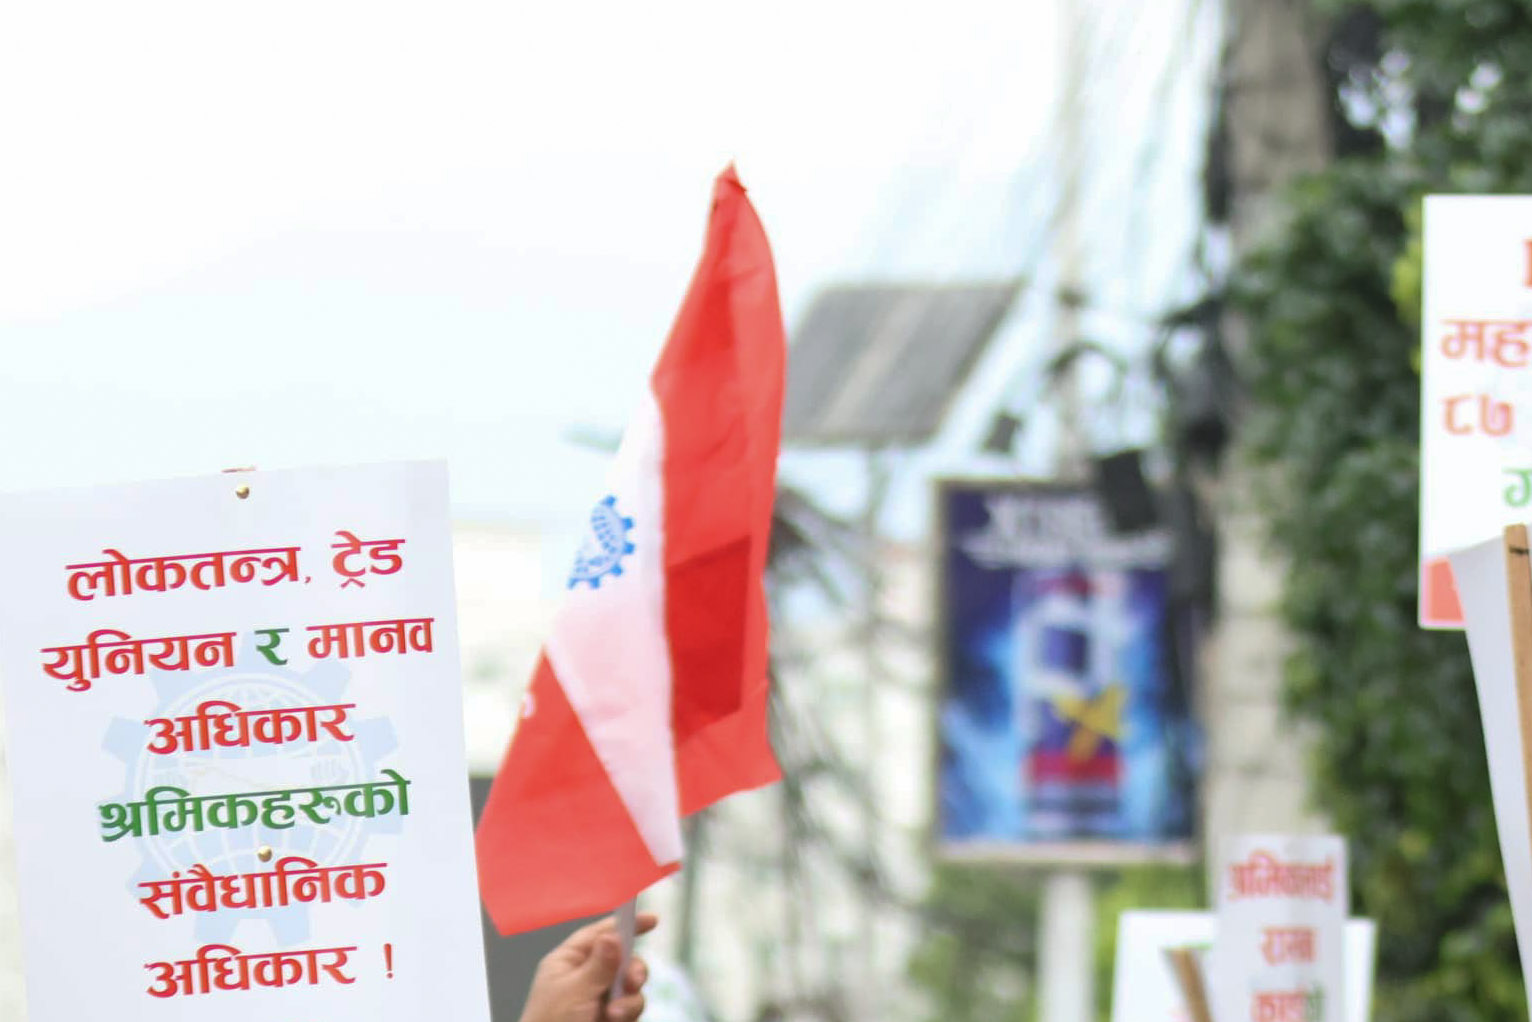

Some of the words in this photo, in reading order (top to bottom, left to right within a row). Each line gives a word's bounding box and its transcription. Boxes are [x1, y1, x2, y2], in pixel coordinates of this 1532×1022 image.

[64, 546, 312, 602] लोकतन्त्र,
[331, 529, 407, 589] ट्रेड
[39, 628, 238, 694] युनियन
[254, 626, 290, 667] र
[304, 616, 436, 660] मानव
[143, 700, 357, 756] अधिकार
[136, 856, 389, 920] संवैधानिक
[143, 942, 359, 999] अधिकार
